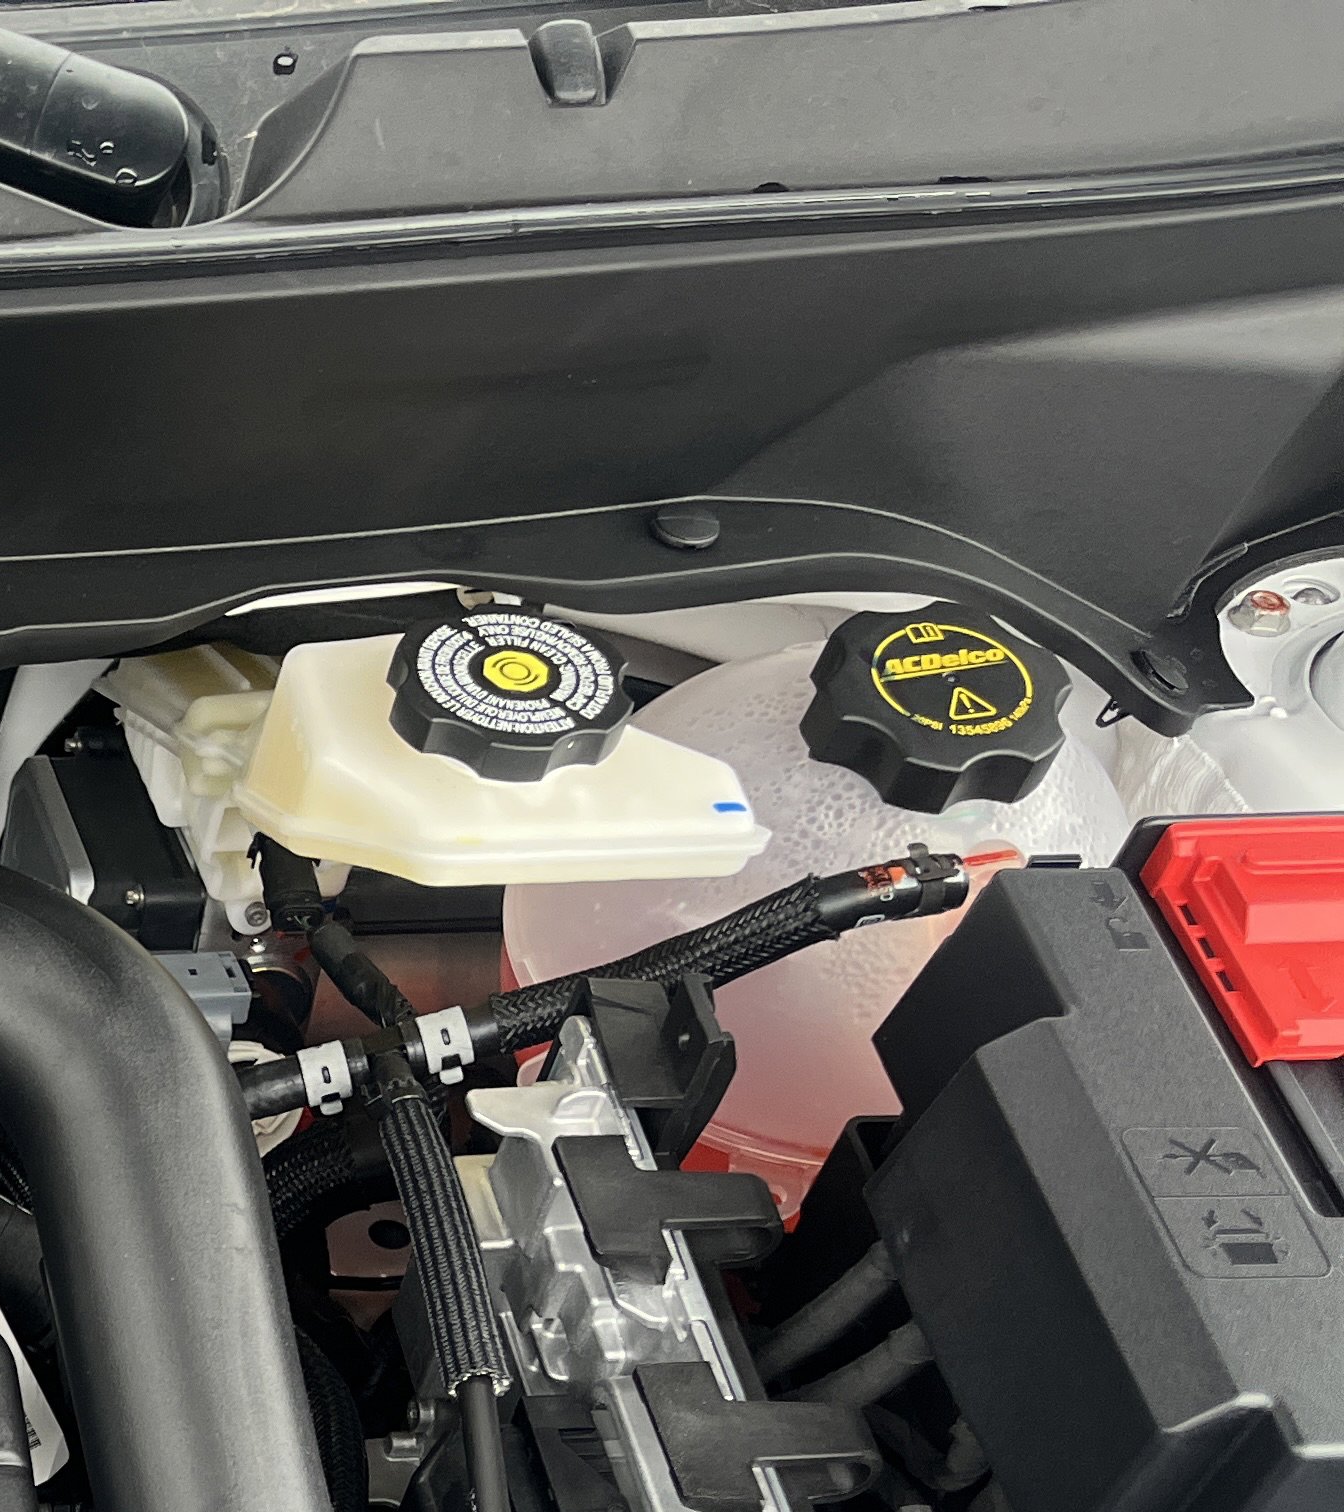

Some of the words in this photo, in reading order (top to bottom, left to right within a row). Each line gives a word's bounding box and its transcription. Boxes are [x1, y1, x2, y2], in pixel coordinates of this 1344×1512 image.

[477, 625, 509, 637] ONLY
[511, 625, 535, 637] USE
[538, 620, 589, 647] SEALED
[484, 635, 530, 647] FILLER
[579, 643, 595, 651] A
[528, 640, 568, 664] CLEAN
[584, 649, 611, 673] FROM
[883, 648, 1006, 675] ACDelco
[440, 698, 461, 712] LE
[458, 695, 479, 708] DU
[473, 702, 498, 716] QUE
[454, 706, 512, 732] NETTOYER
